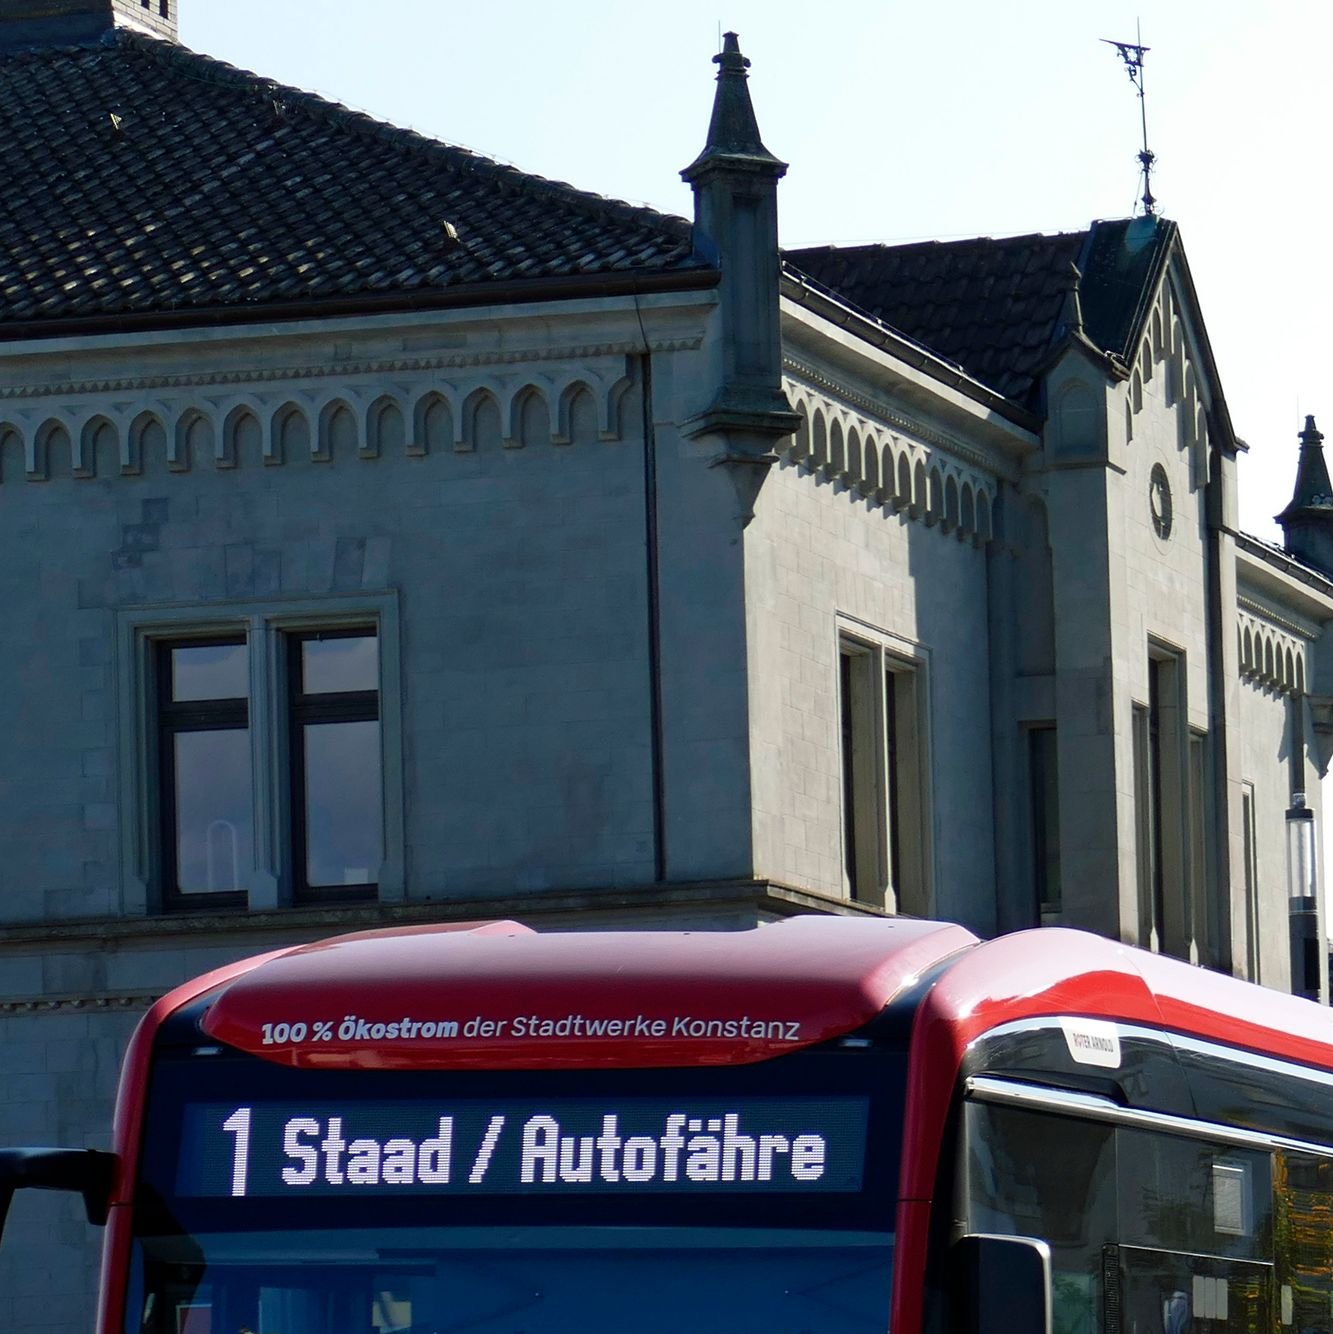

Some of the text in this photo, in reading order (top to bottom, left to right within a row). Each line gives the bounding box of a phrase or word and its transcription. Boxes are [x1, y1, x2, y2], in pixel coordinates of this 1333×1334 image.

[261, 1015, 800, 1045] 100 % Ökostrom der Stadtwerke Konstanz
[223, 1107, 825, 1197] 1 Staad / Autofähre
